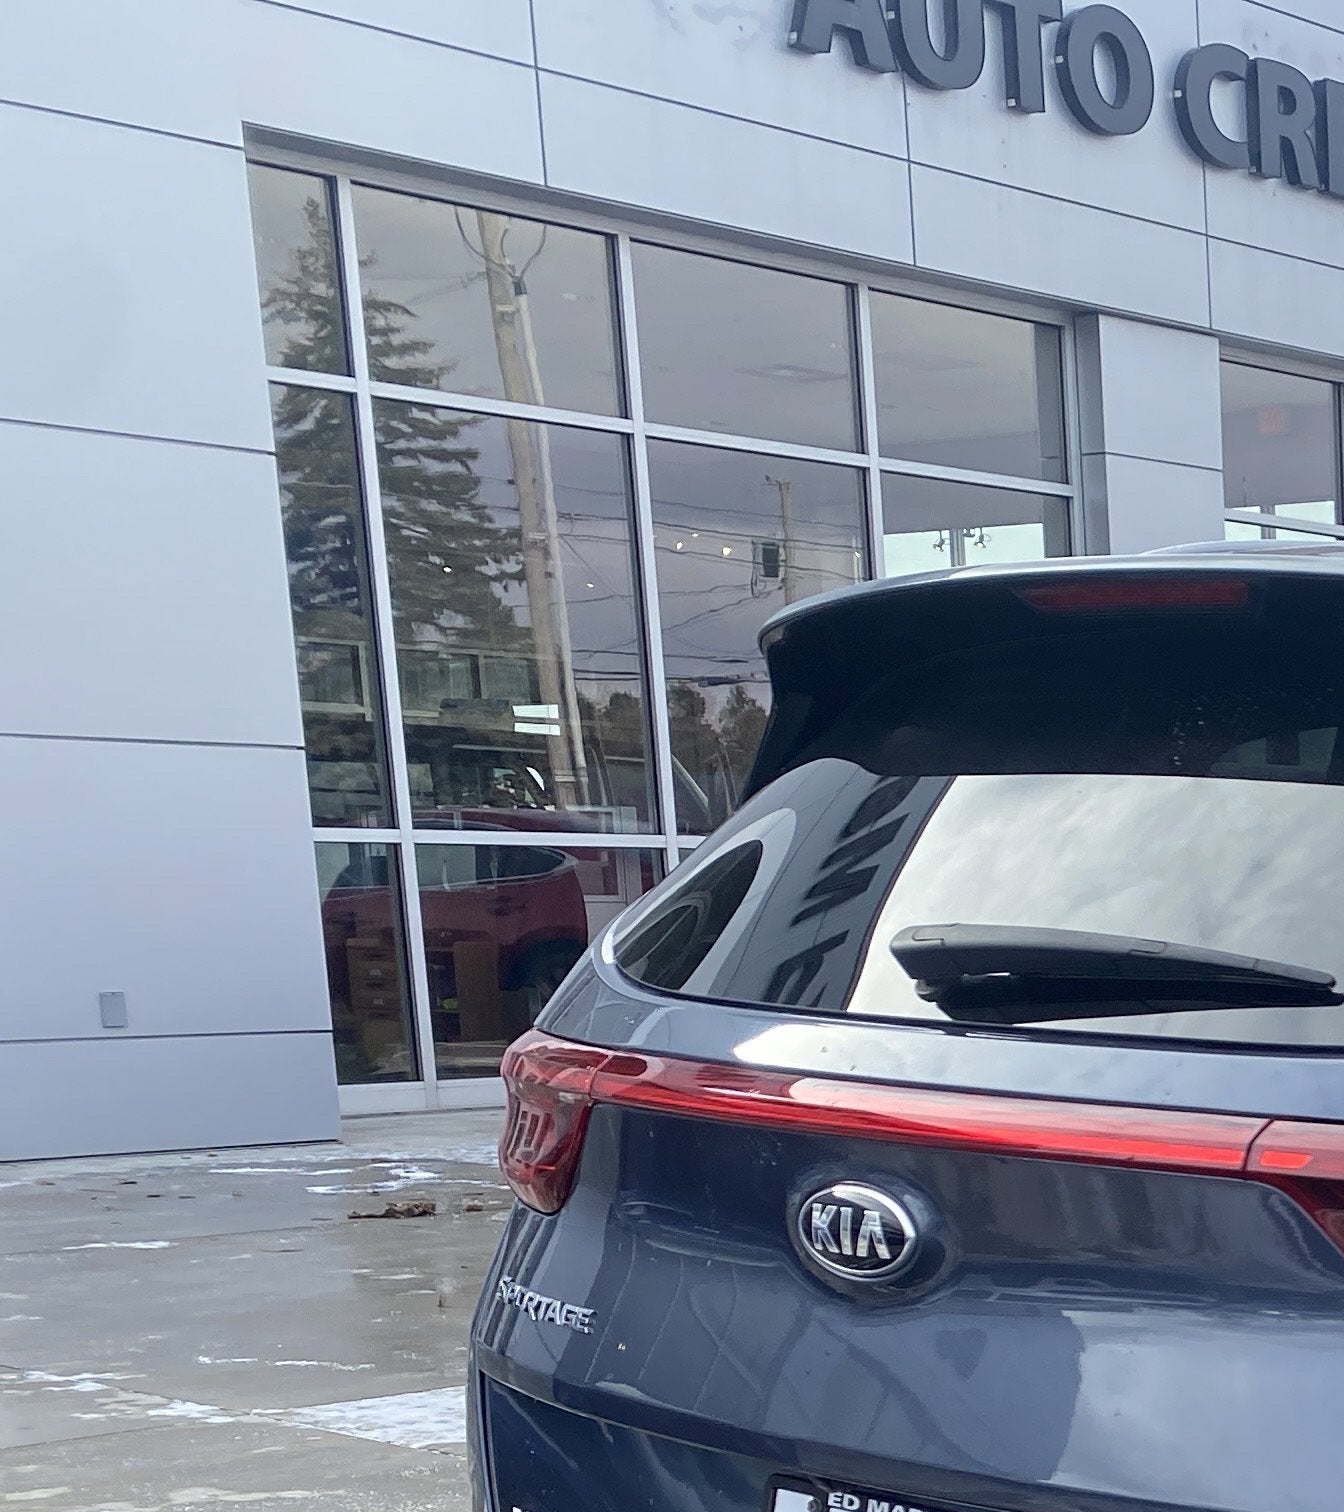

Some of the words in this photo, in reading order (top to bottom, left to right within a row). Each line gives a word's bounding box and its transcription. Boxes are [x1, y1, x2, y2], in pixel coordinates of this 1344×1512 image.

[811, 1202, 891, 1259] KIA
[496, 1275, 595, 1335] SPORTAGE
[827, 1491, 860, 1511] ED
